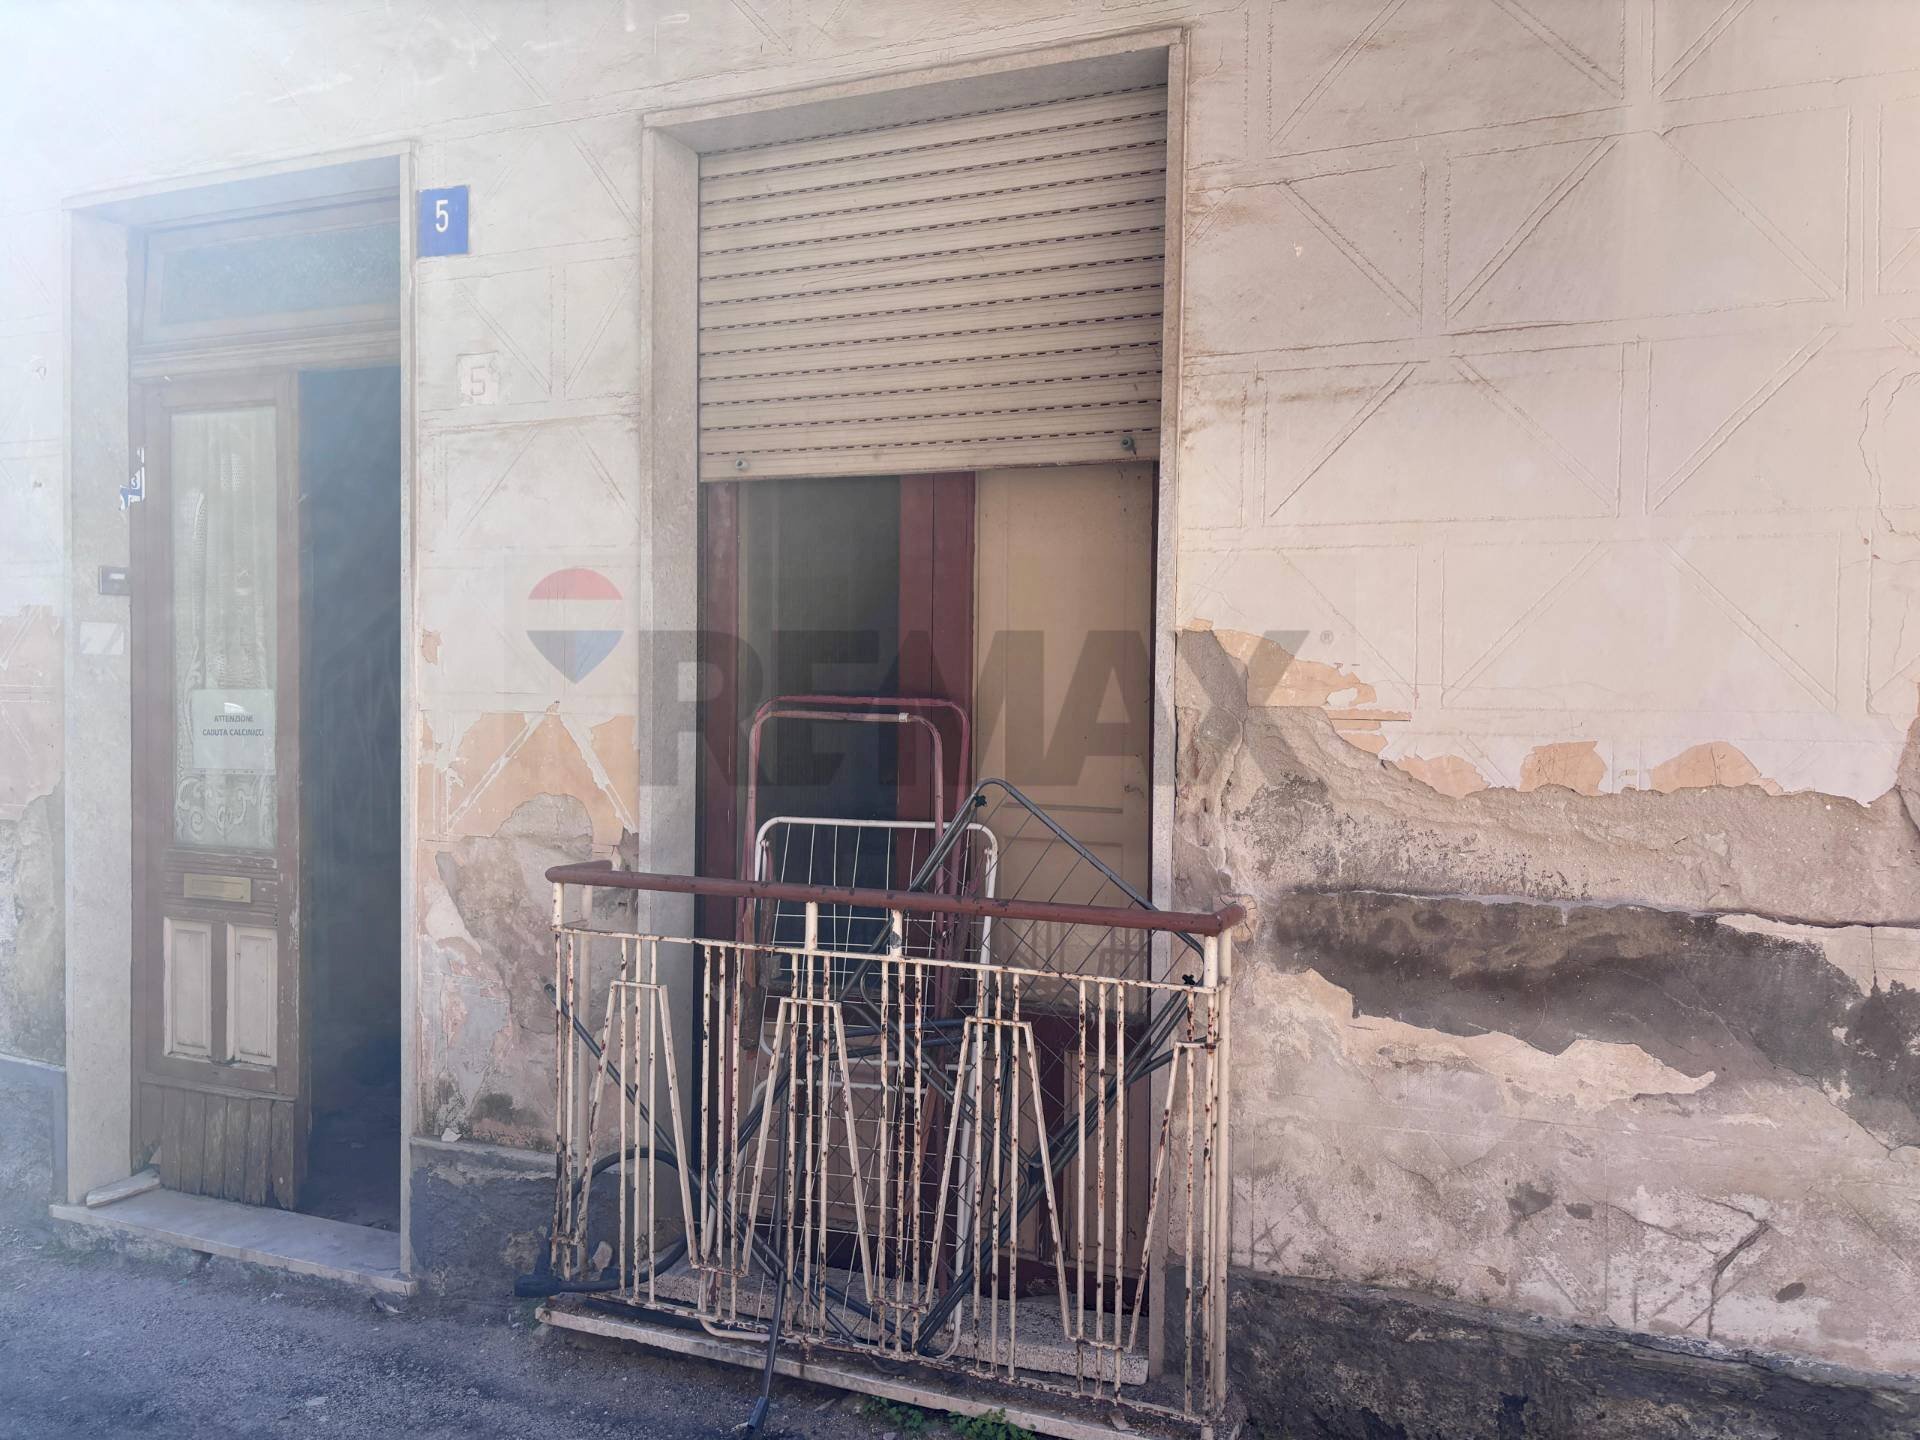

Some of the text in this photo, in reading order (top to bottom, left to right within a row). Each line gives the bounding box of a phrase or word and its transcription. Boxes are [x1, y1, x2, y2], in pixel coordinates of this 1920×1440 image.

[435, 199, 449, 233] 5
[470, 365, 487, 397] 5
[214, 714, 255, 723] ATTENZIONE
[202, 728, 265, 737] CADUTA CALCINACCI
